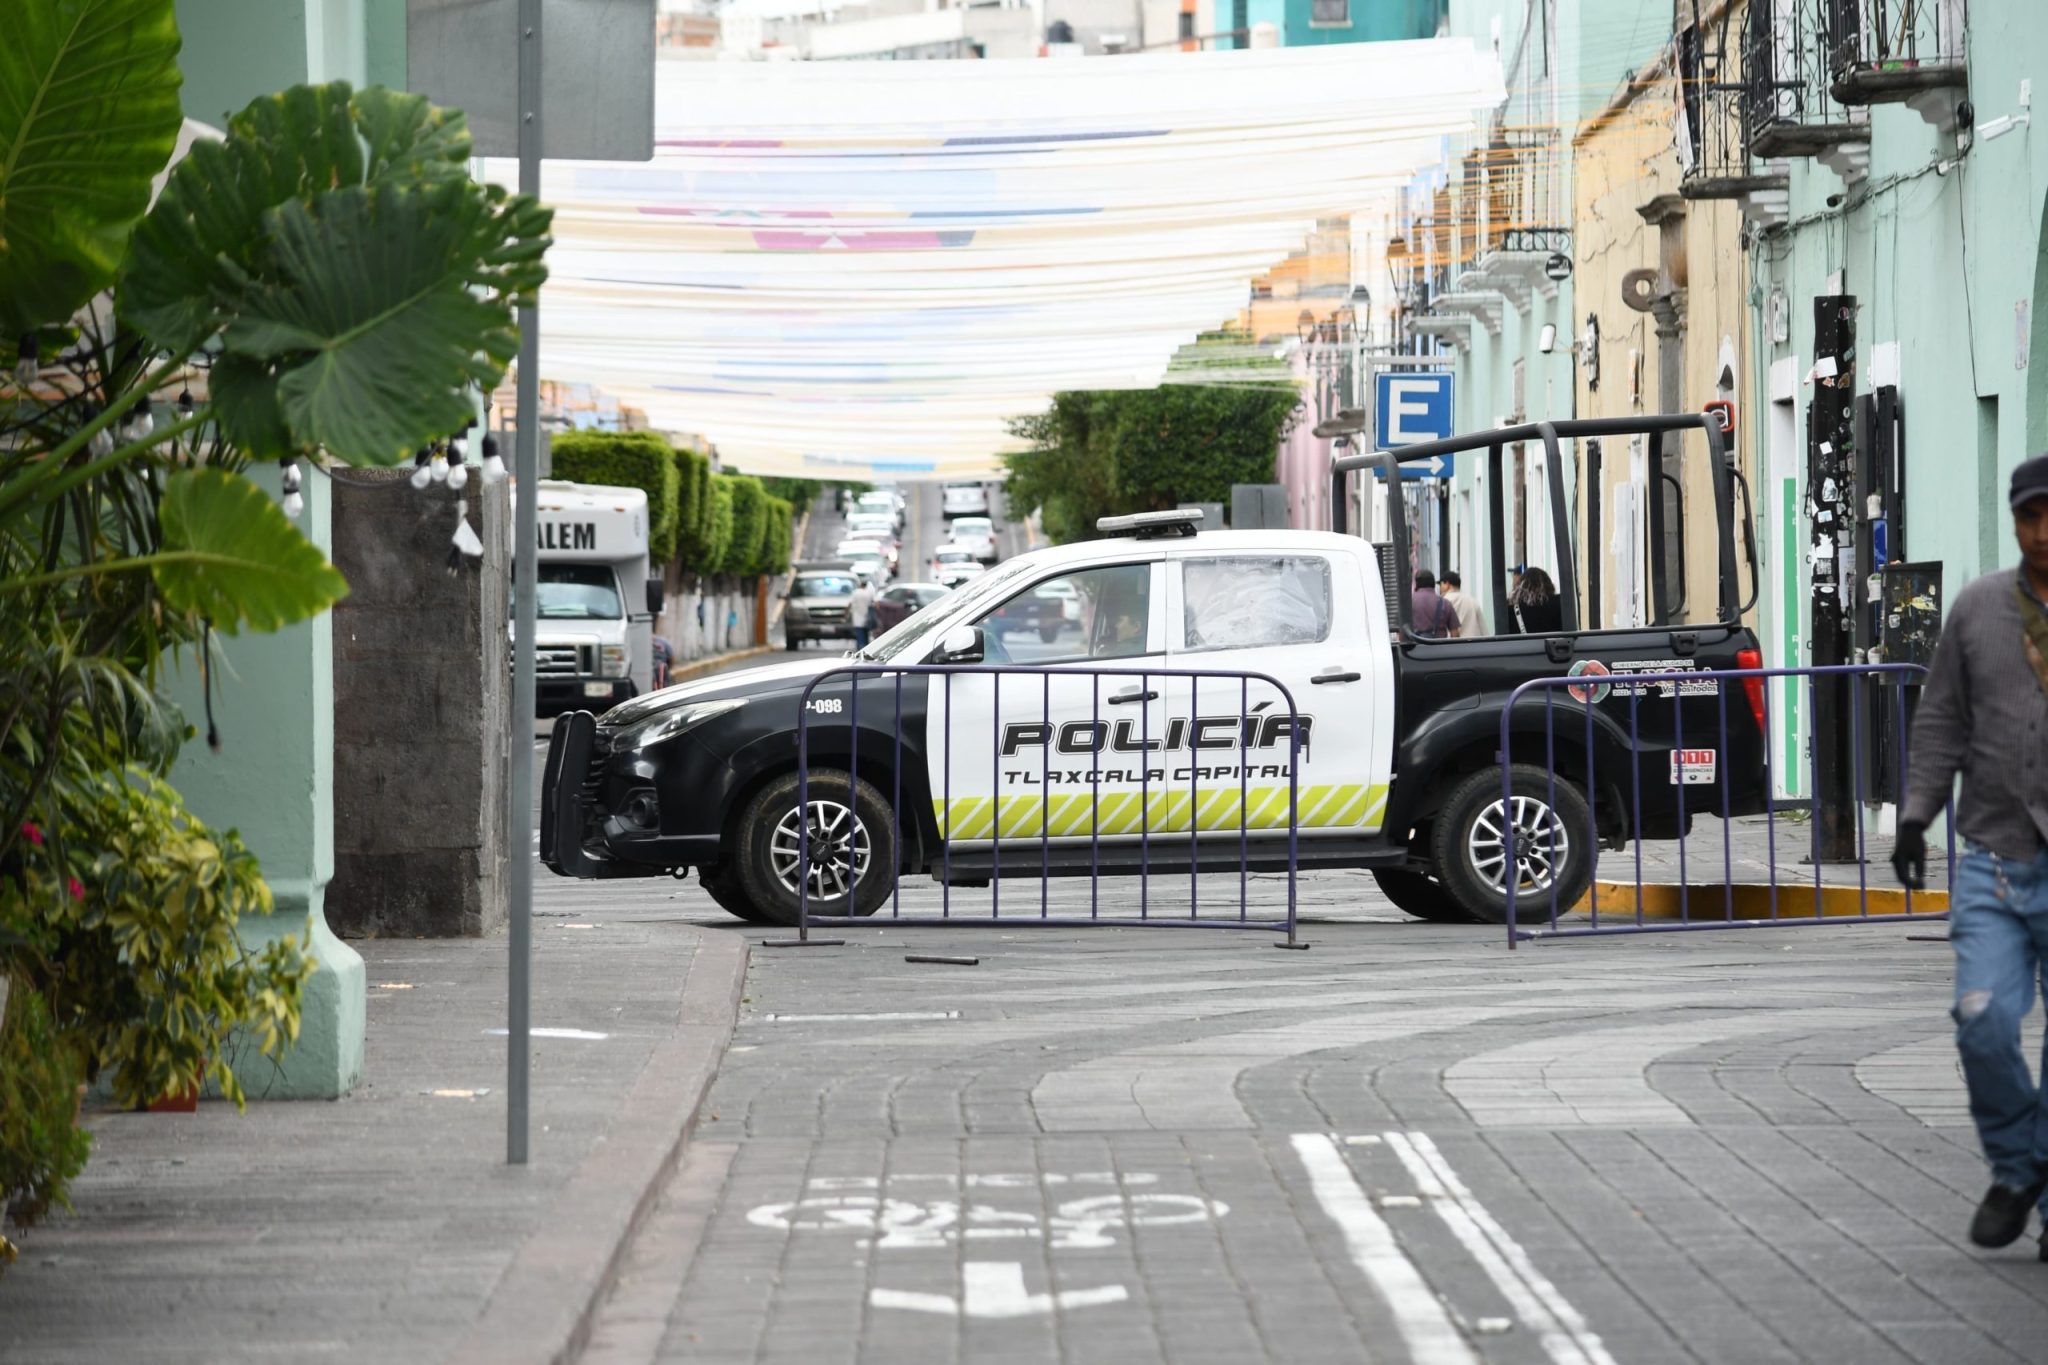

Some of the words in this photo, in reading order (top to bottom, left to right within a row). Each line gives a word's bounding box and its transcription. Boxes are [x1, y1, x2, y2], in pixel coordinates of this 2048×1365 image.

[1388, 380, 1440, 444] E
[1000, 701, 1315, 757] POLICÍA
[1004, 768, 1165, 784] TLAXCALA
[1173, 765, 1296, 780] CAPITAL
